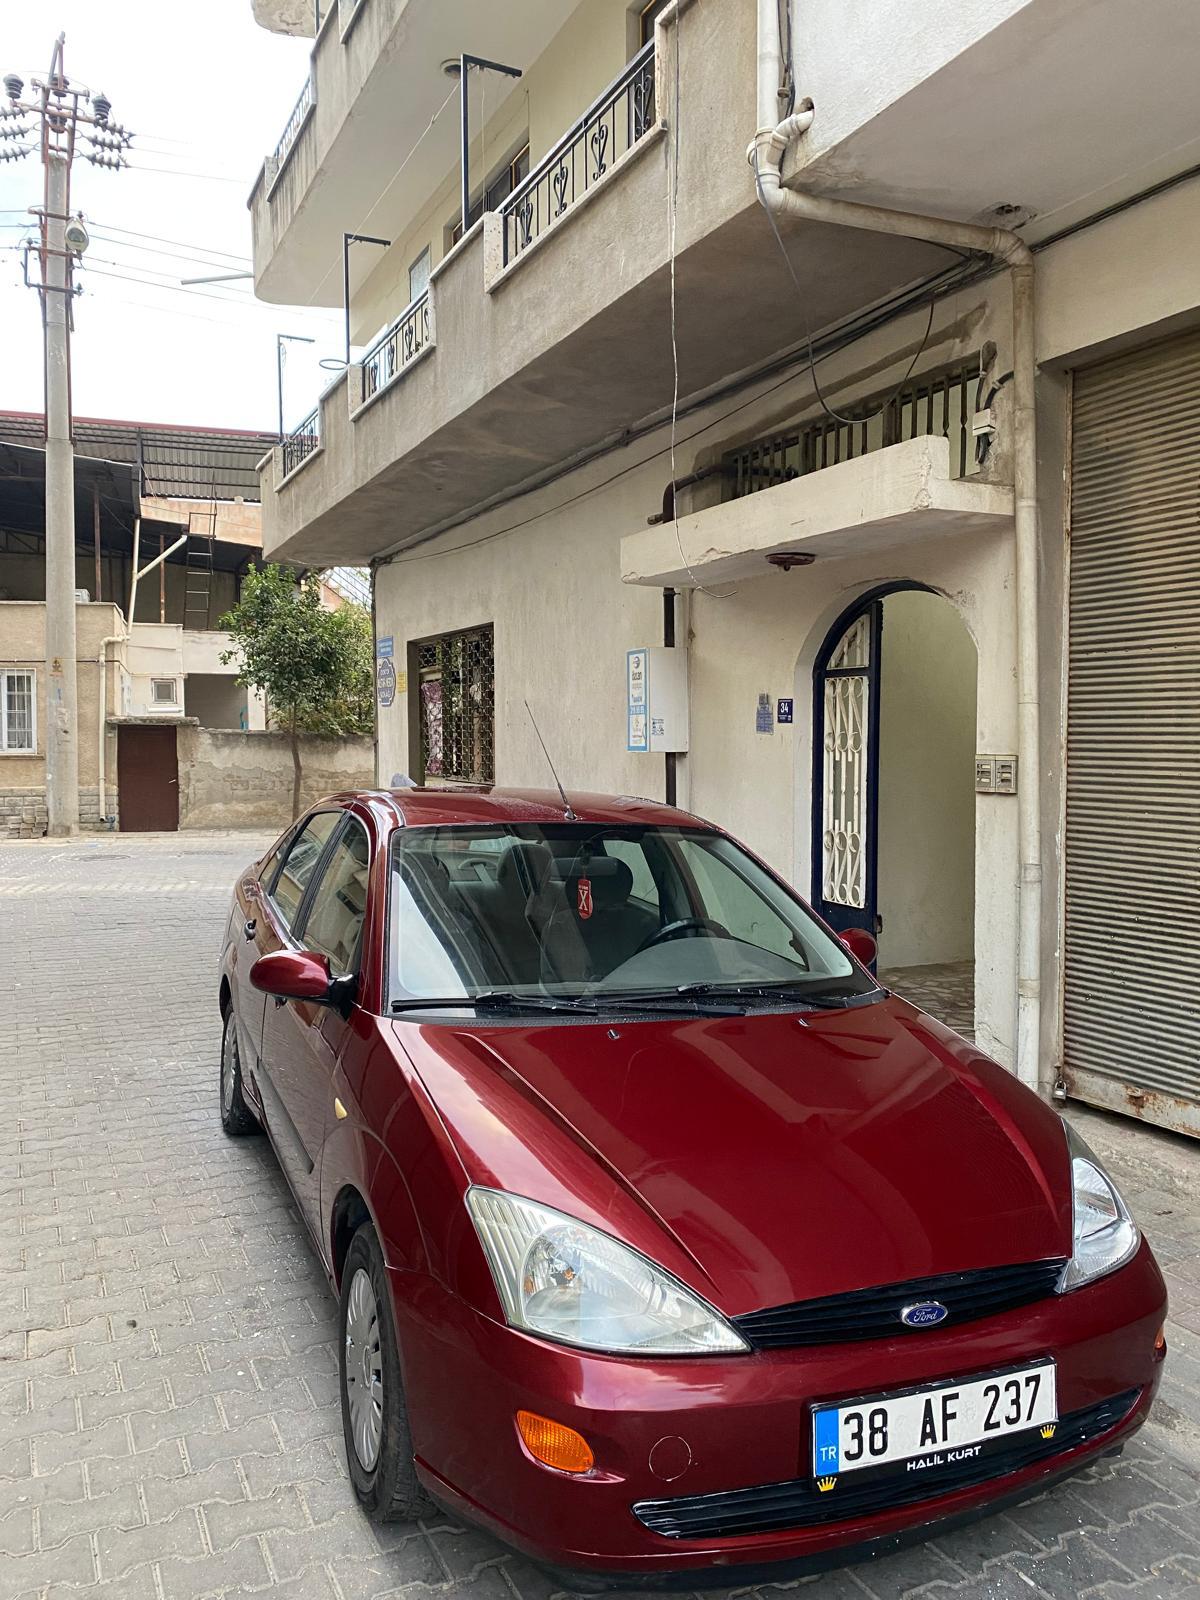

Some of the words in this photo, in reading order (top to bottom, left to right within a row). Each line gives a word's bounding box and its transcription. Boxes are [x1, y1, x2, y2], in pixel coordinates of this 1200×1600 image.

[780, 702, 789, 713] 34
[913, 1308, 938, 1322] Ford
[820, 1446, 837, 1461] TR
[843, 1407, 889, 1461] 38
[920, 1392, 960, 1447] AF
[983, 1374, 1041, 1431] 237
[906, 1450, 945, 1471] HALİL
[947, 1446, 982, 1463] KURT
